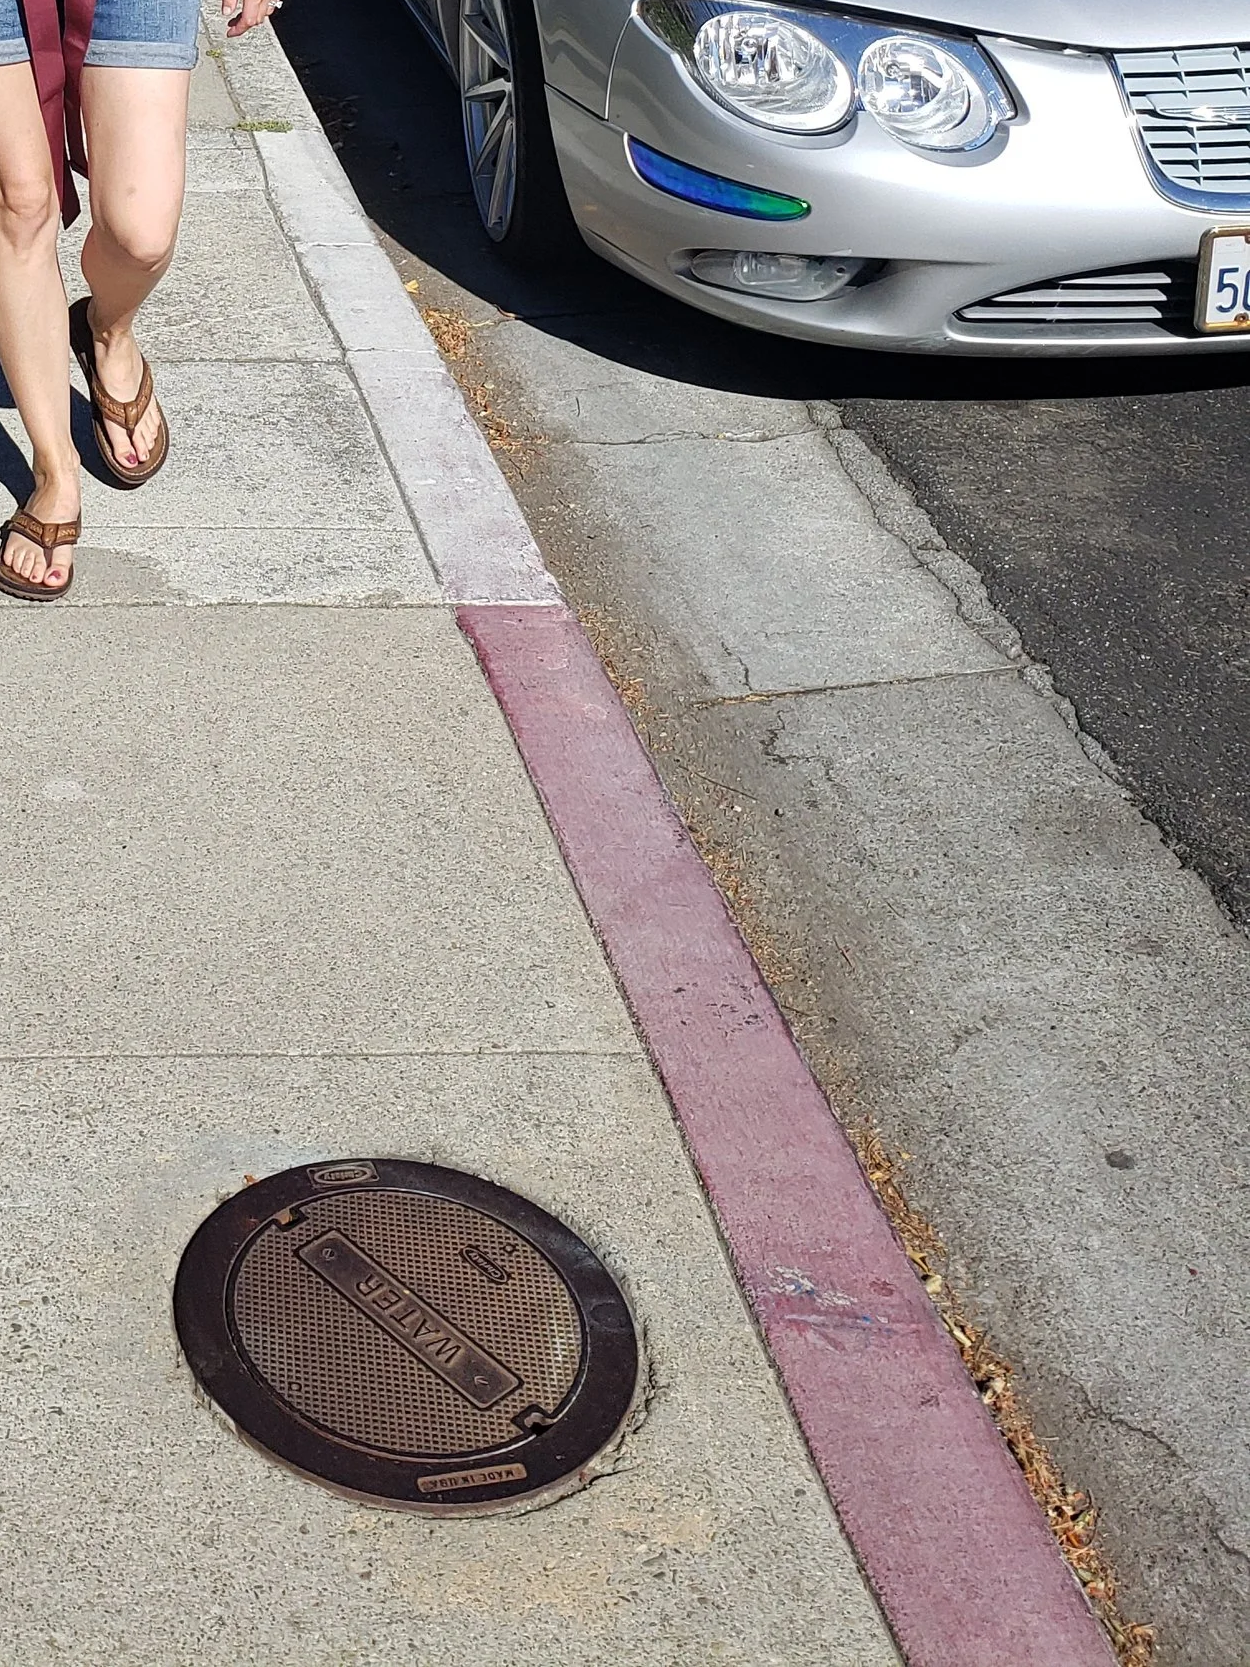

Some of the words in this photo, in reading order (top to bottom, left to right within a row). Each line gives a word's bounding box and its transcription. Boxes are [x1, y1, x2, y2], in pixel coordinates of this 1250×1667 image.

[355, 1273, 463, 1365] WATER
[461, 1474, 476, 1484] IN
[480, 1469, 515, 1482] MADE
[429, 1477, 458, 1489] USA
